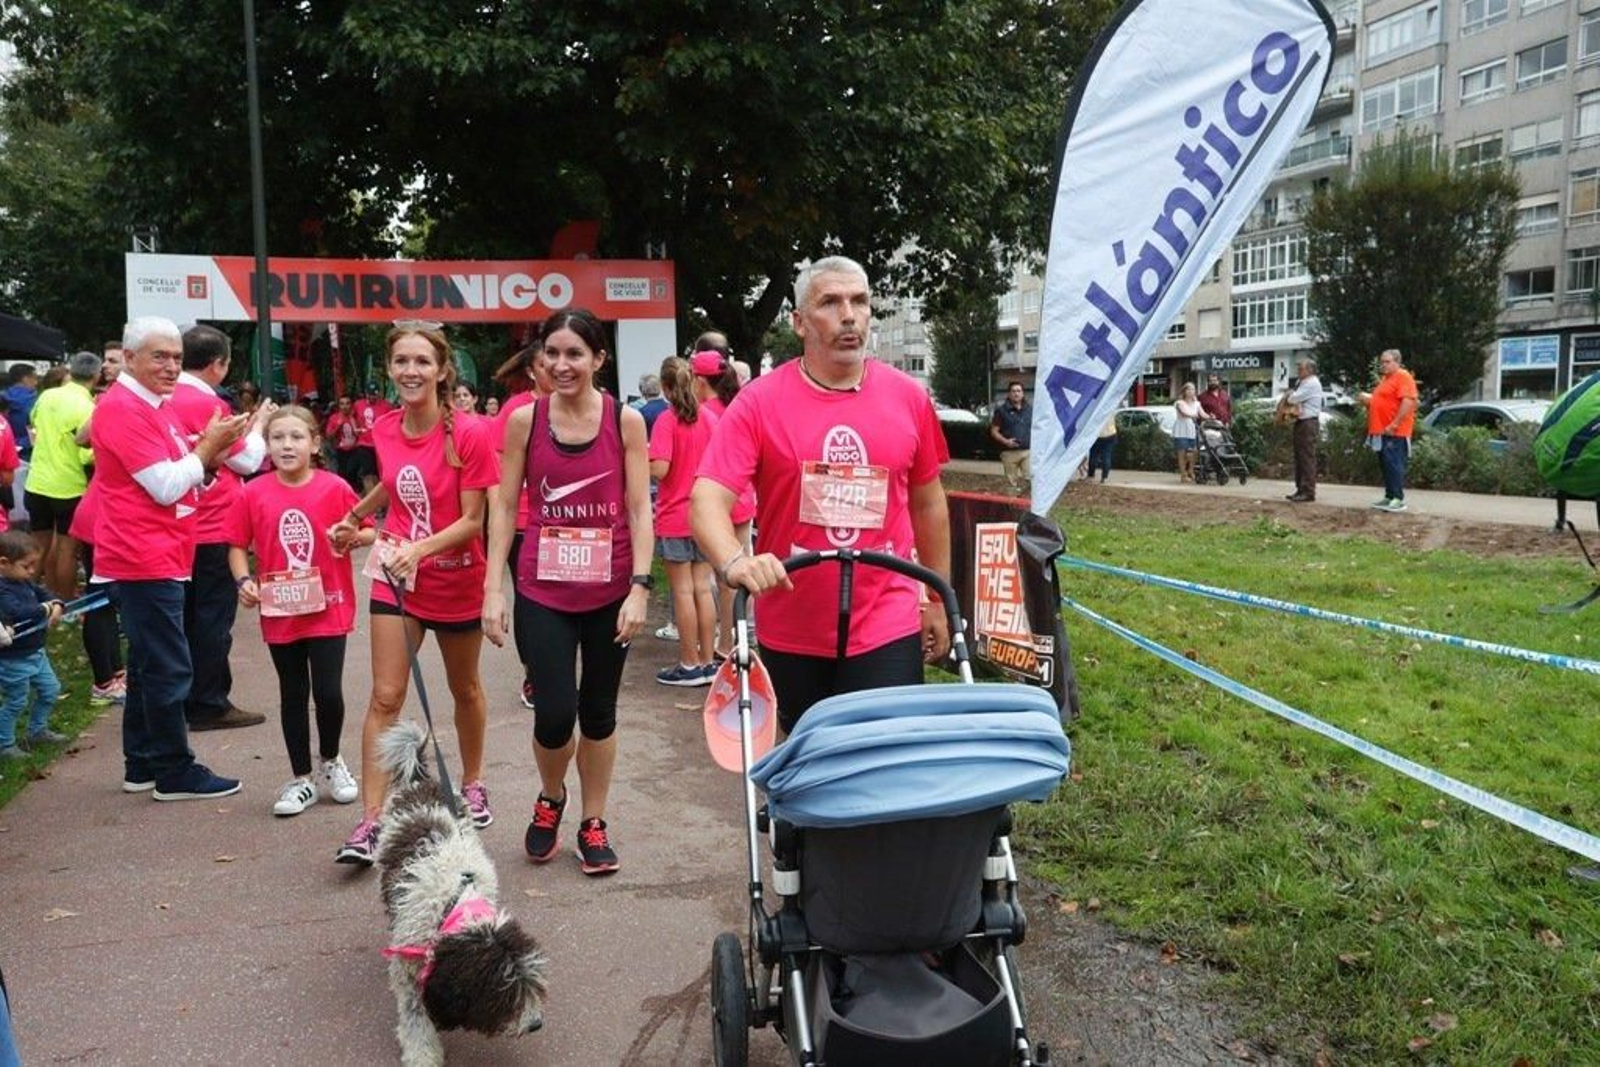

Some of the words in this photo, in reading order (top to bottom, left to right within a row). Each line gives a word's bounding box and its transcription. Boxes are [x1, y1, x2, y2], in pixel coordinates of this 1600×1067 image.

[1045, 31, 1300, 448] Atlántico
[136, 277, 181, 287] CONCELLO
[608, 281, 647, 289] CONCELLO
[1211, 355, 1260, 369] farmacia
[828, 450, 860, 462] VIGO
[541, 502, 618, 519] RUNNING
[558, 545, 591, 566] 680
[980, 533, 1017, 565] SAV
[980, 566, 1016, 599] THE
[272, 583, 310, 604] 5667
[989, 639, 1037, 672] EUROP
